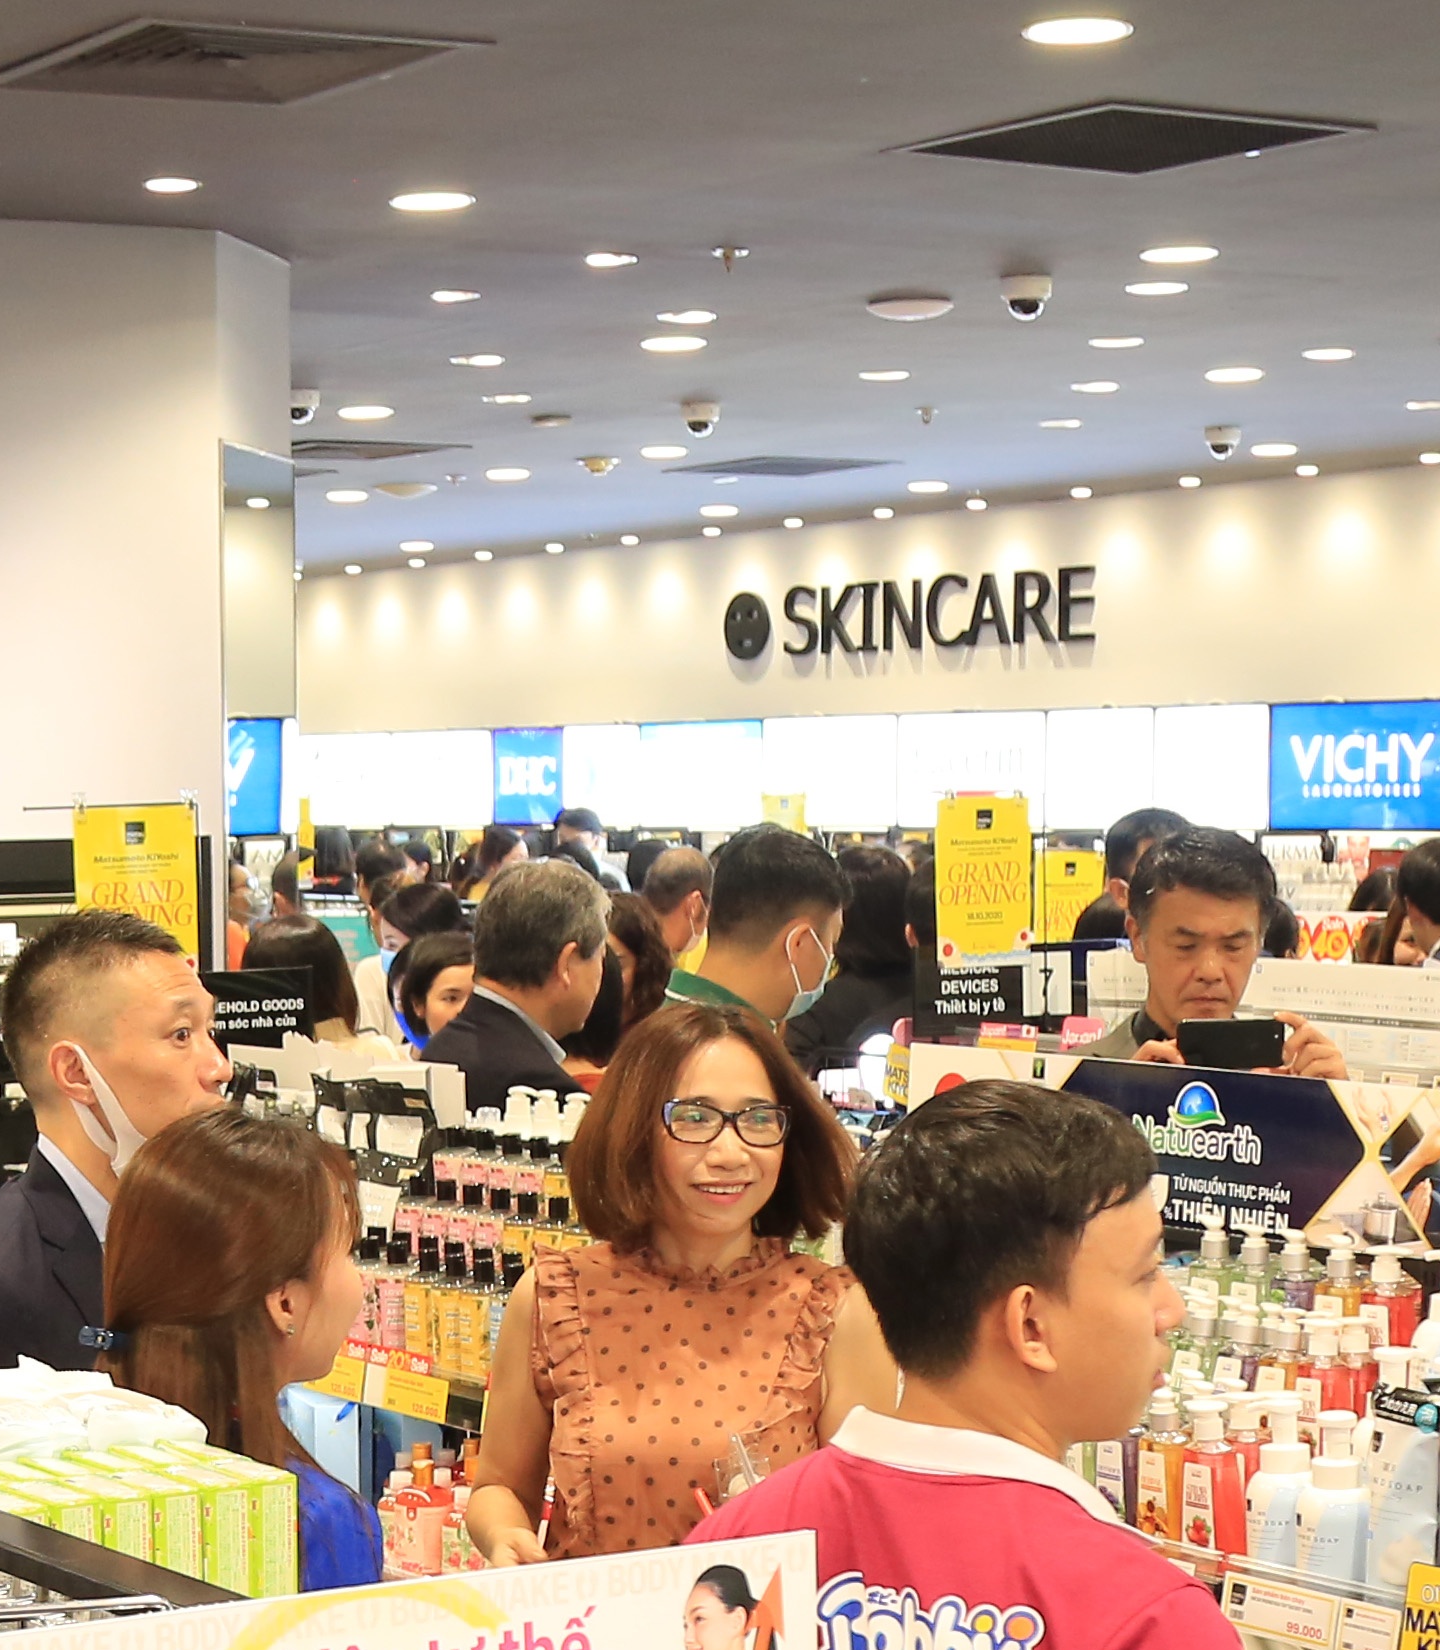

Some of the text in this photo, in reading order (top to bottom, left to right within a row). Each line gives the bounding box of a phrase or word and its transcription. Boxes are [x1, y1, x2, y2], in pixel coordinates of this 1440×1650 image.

[785, 567, 1096, 657] SKINCARE
[1290, 733, 1435, 783] VICHY
[500, 752, 556, 797] DHC
[948, 861, 1021, 883] GRAND
[91, 878, 185, 905] GRAND
[939, 882, 1027, 906] OPENING
[941, 979, 999, 996] DEVICES
[262, 997, 304, 1013] GOODS
[935, 999, 967, 1014] Thiết
[982, 1003, 991, 1017] y
[228, 1015, 249, 1030] sóc
[251, 1013, 273, 1028] nhà
[370, 1346, 389, 1363] Sale
[411, 1359, 430, 1375] Sale
[1286, 1621, 1323, 1641] 99.000
